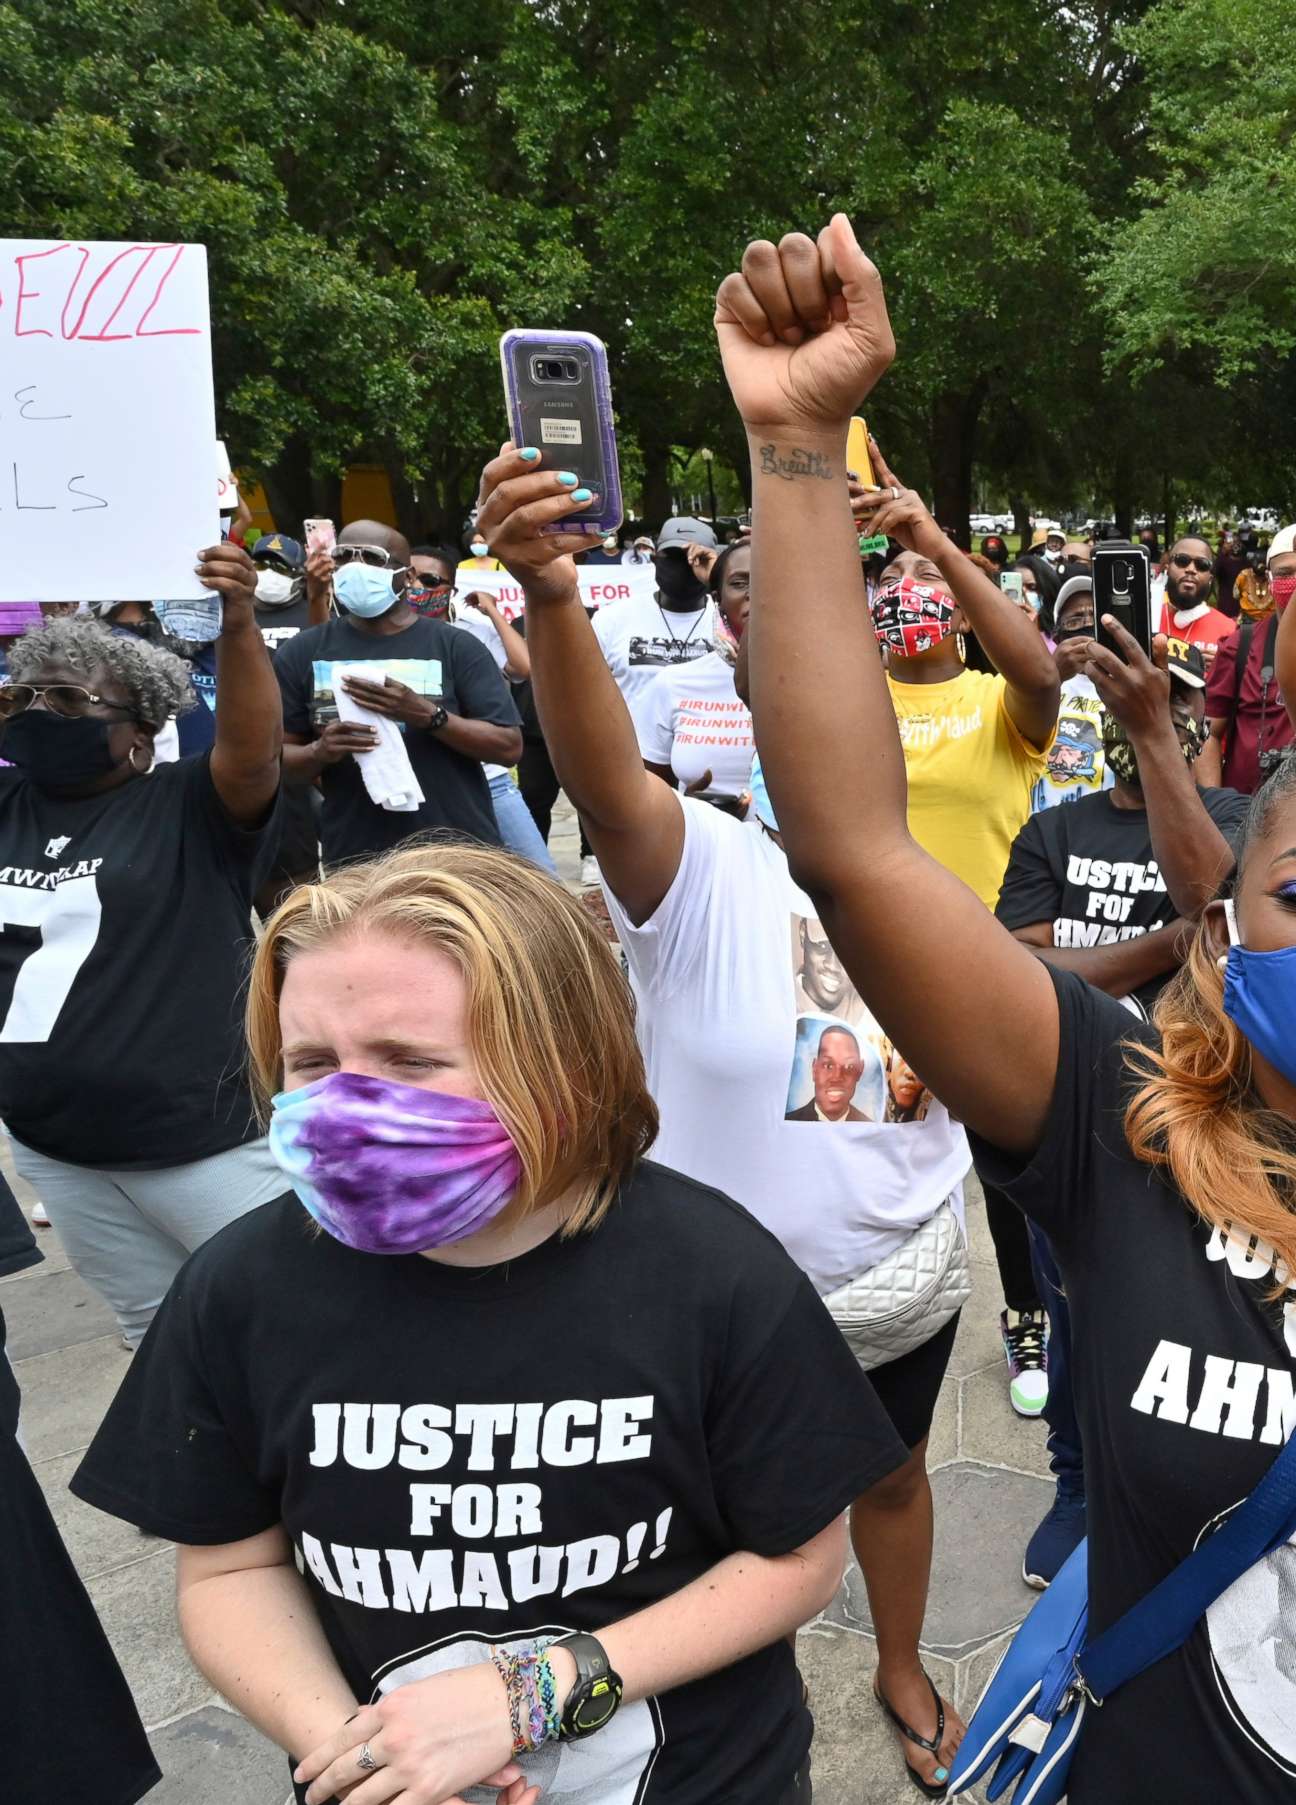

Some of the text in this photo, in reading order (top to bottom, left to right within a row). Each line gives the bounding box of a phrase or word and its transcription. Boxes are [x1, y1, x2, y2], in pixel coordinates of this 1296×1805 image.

[590, 585, 630, 600] FOR
[679, 700, 744, 712] #IRUNWI
[308, 1395, 655, 1471] JUSTICE
[409, 1482, 543, 1538] FOR
[295, 1506, 674, 1614] AHMAUD!!
